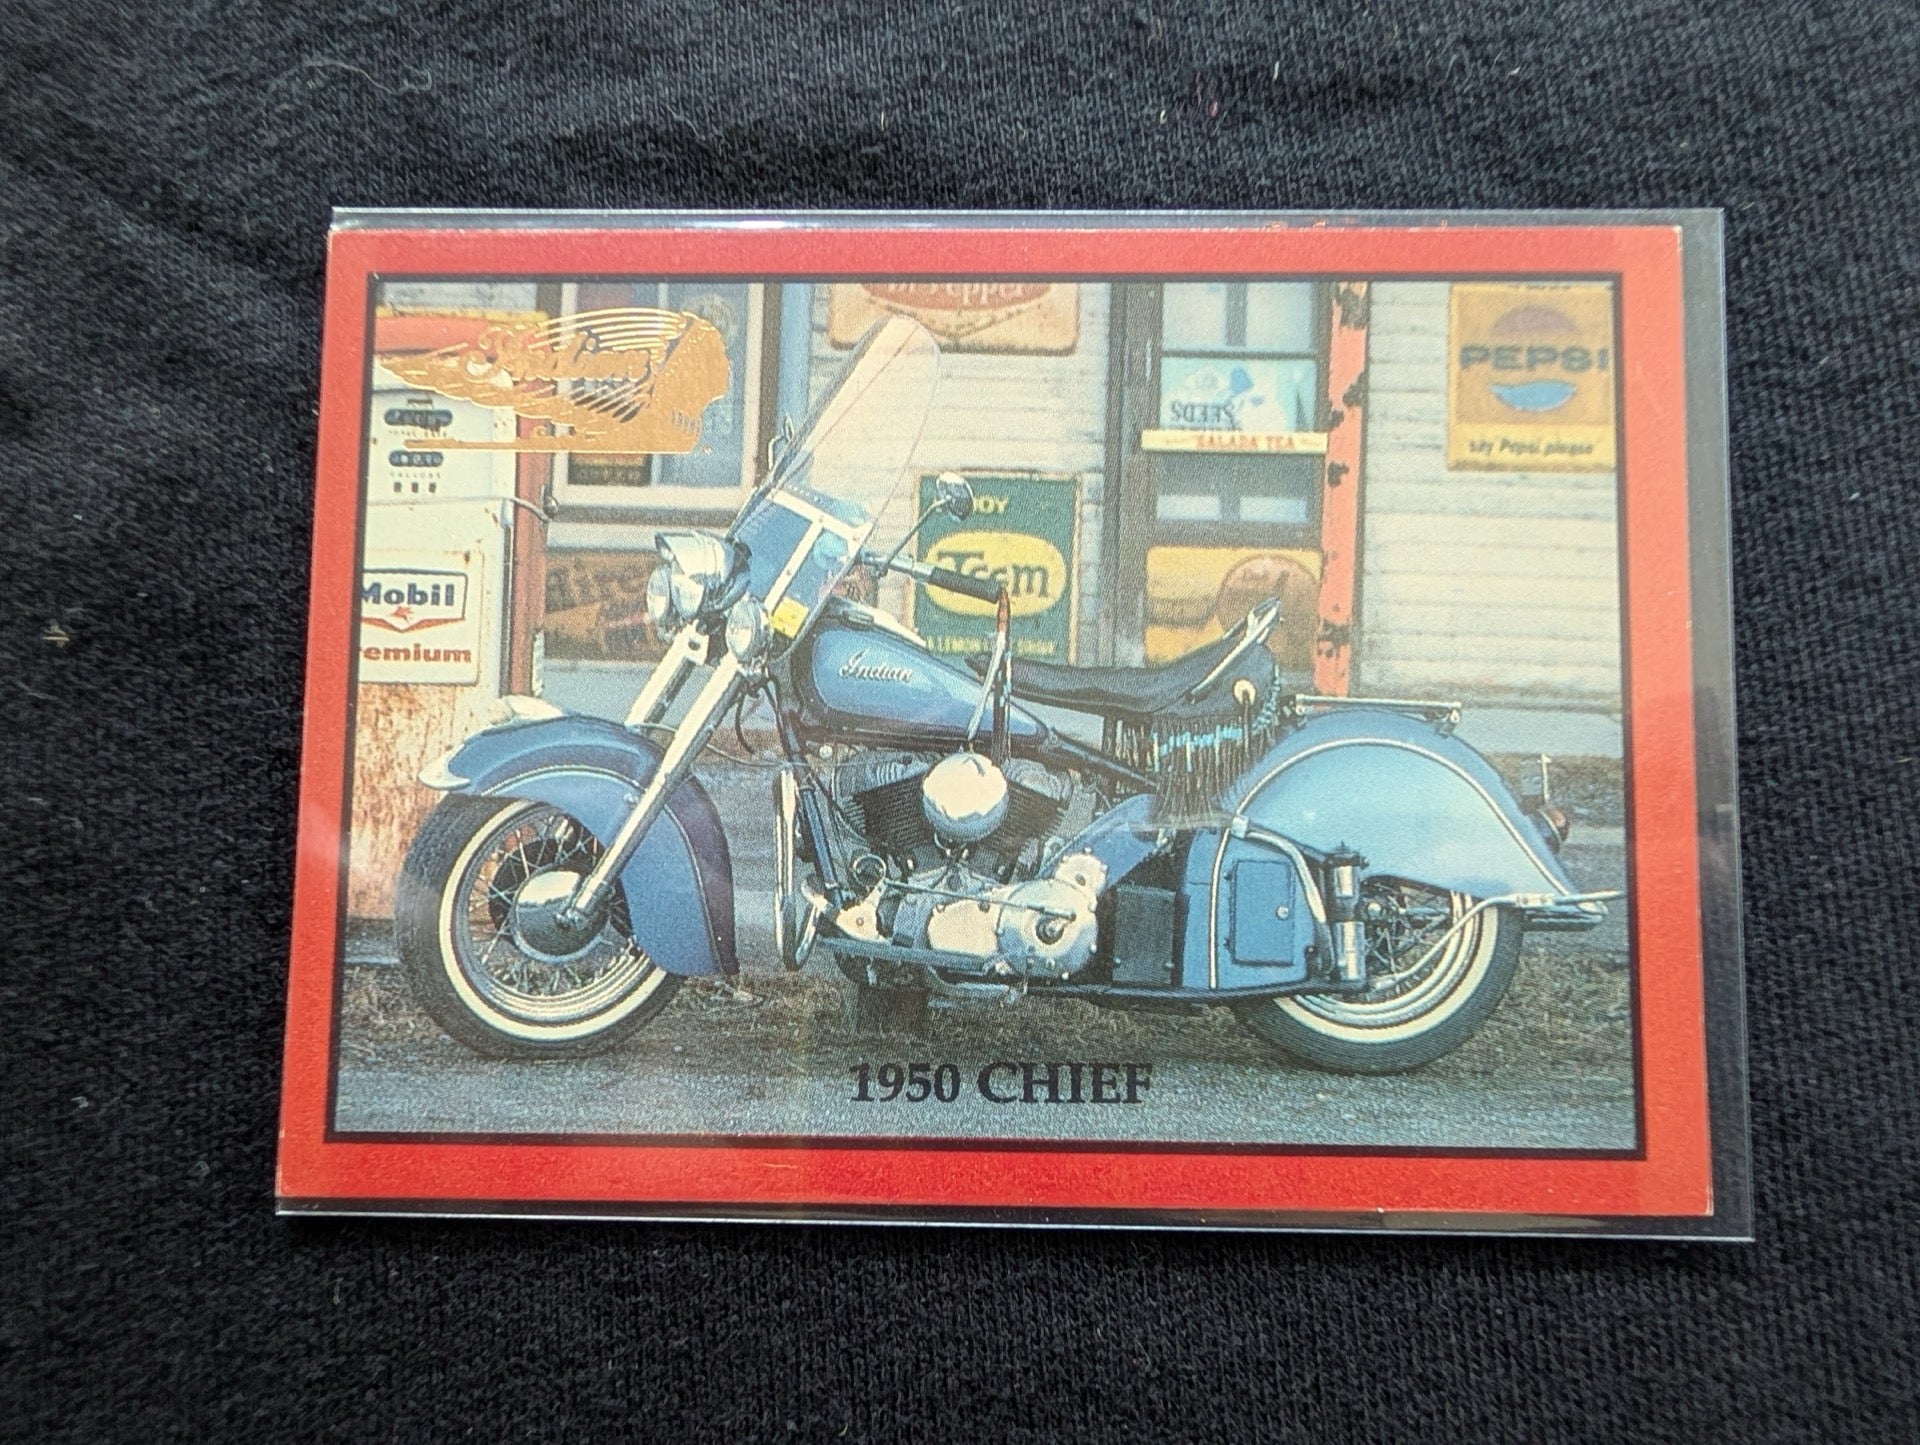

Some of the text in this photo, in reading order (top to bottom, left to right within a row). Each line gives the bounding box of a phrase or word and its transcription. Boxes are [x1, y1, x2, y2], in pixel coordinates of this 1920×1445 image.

[1460, 343, 1609, 373] PEPSI
[361, 582, 455, 606] Mobil
[360, 643, 472, 662] emium
[838, 646, 913, 683] Indian
[848, 1062, 1153, 1104] 1950 CHIEF
